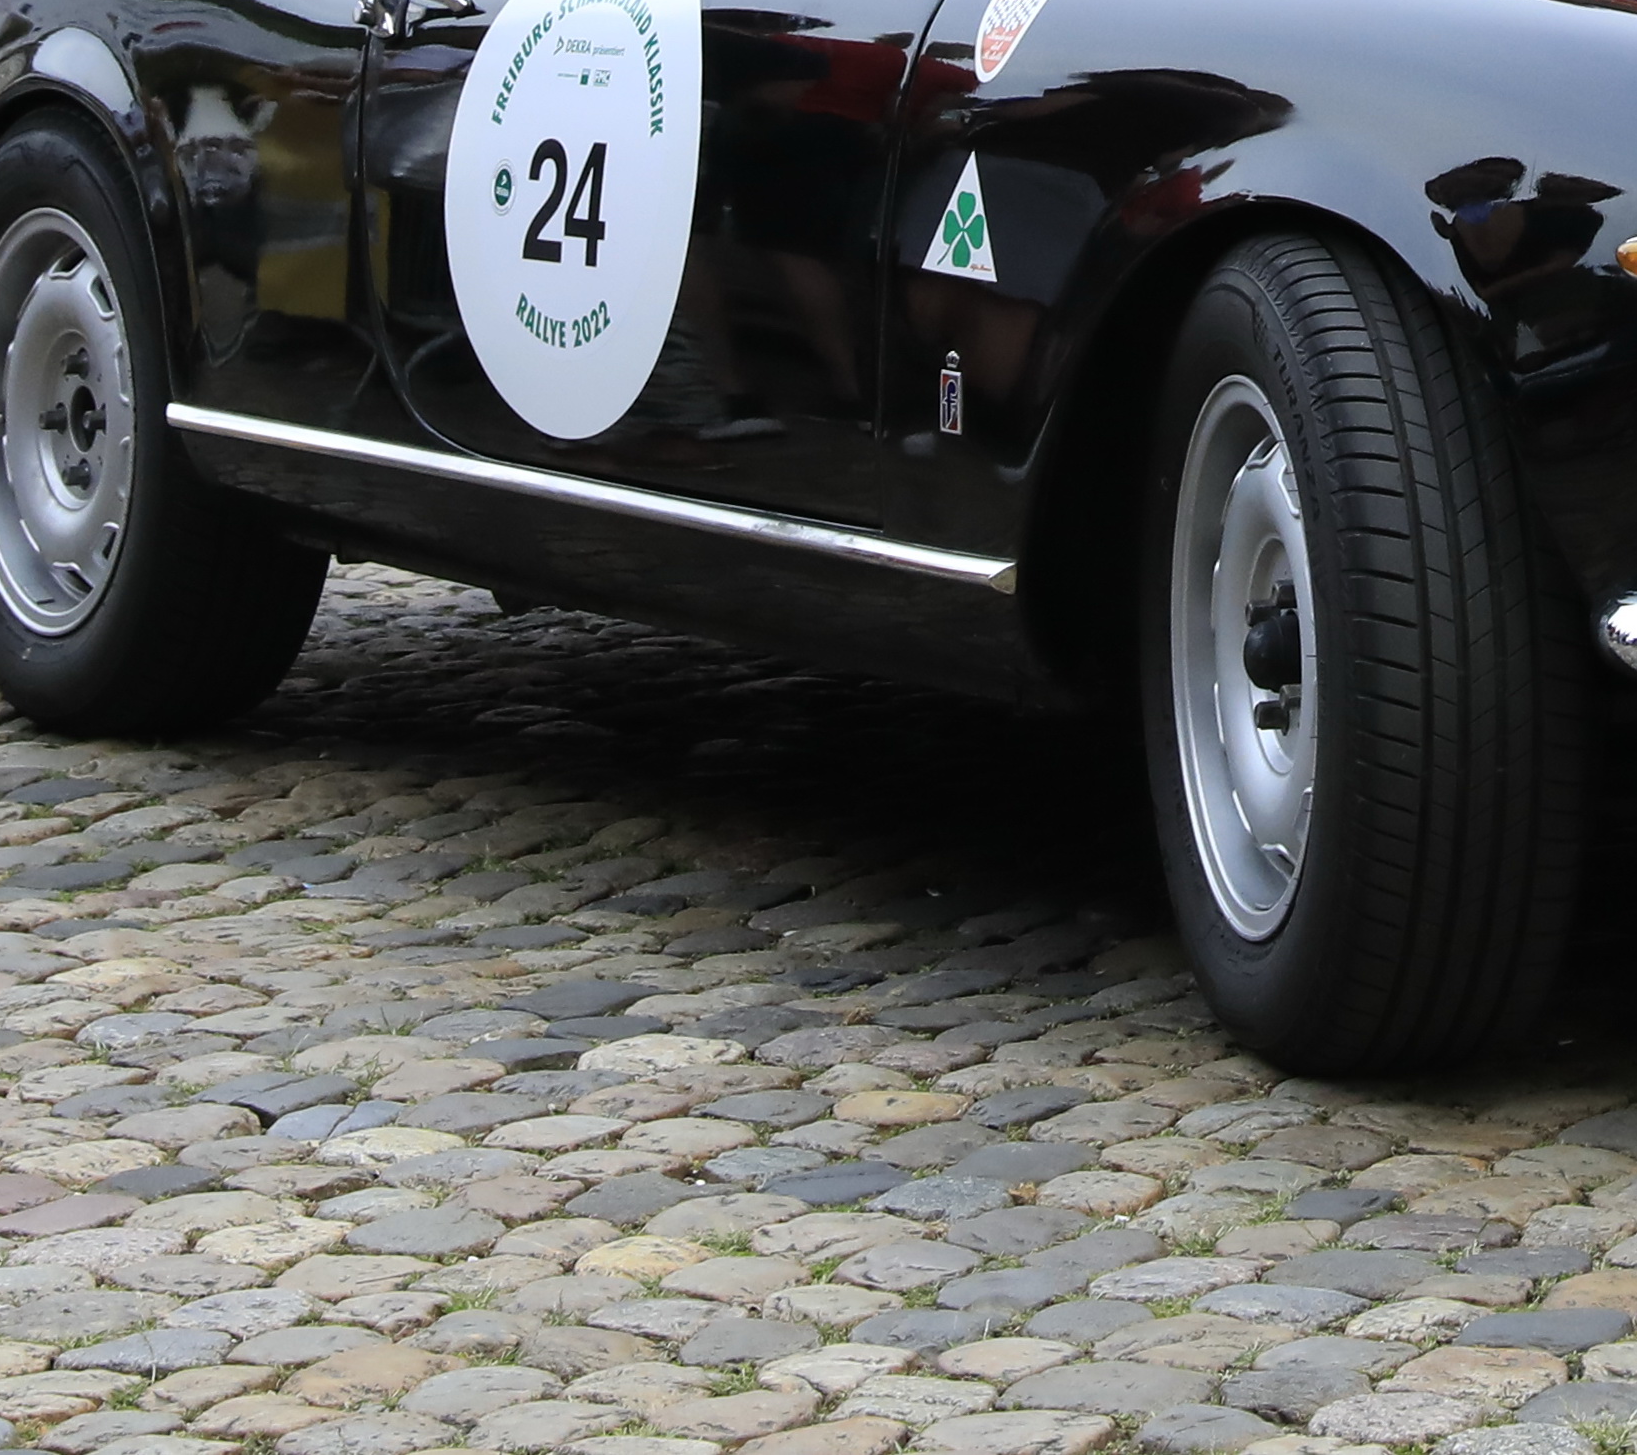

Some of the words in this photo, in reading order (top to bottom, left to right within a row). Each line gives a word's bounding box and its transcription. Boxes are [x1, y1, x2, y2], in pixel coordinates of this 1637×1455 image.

[491, 11, 553, 126] FREIBURG
[644, 32, 664, 139] KLASSIK
[522, 139, 608, 268] 24
[515, 292, 566, 349] RALLYE
[572, 301, 611, 348] 2022
